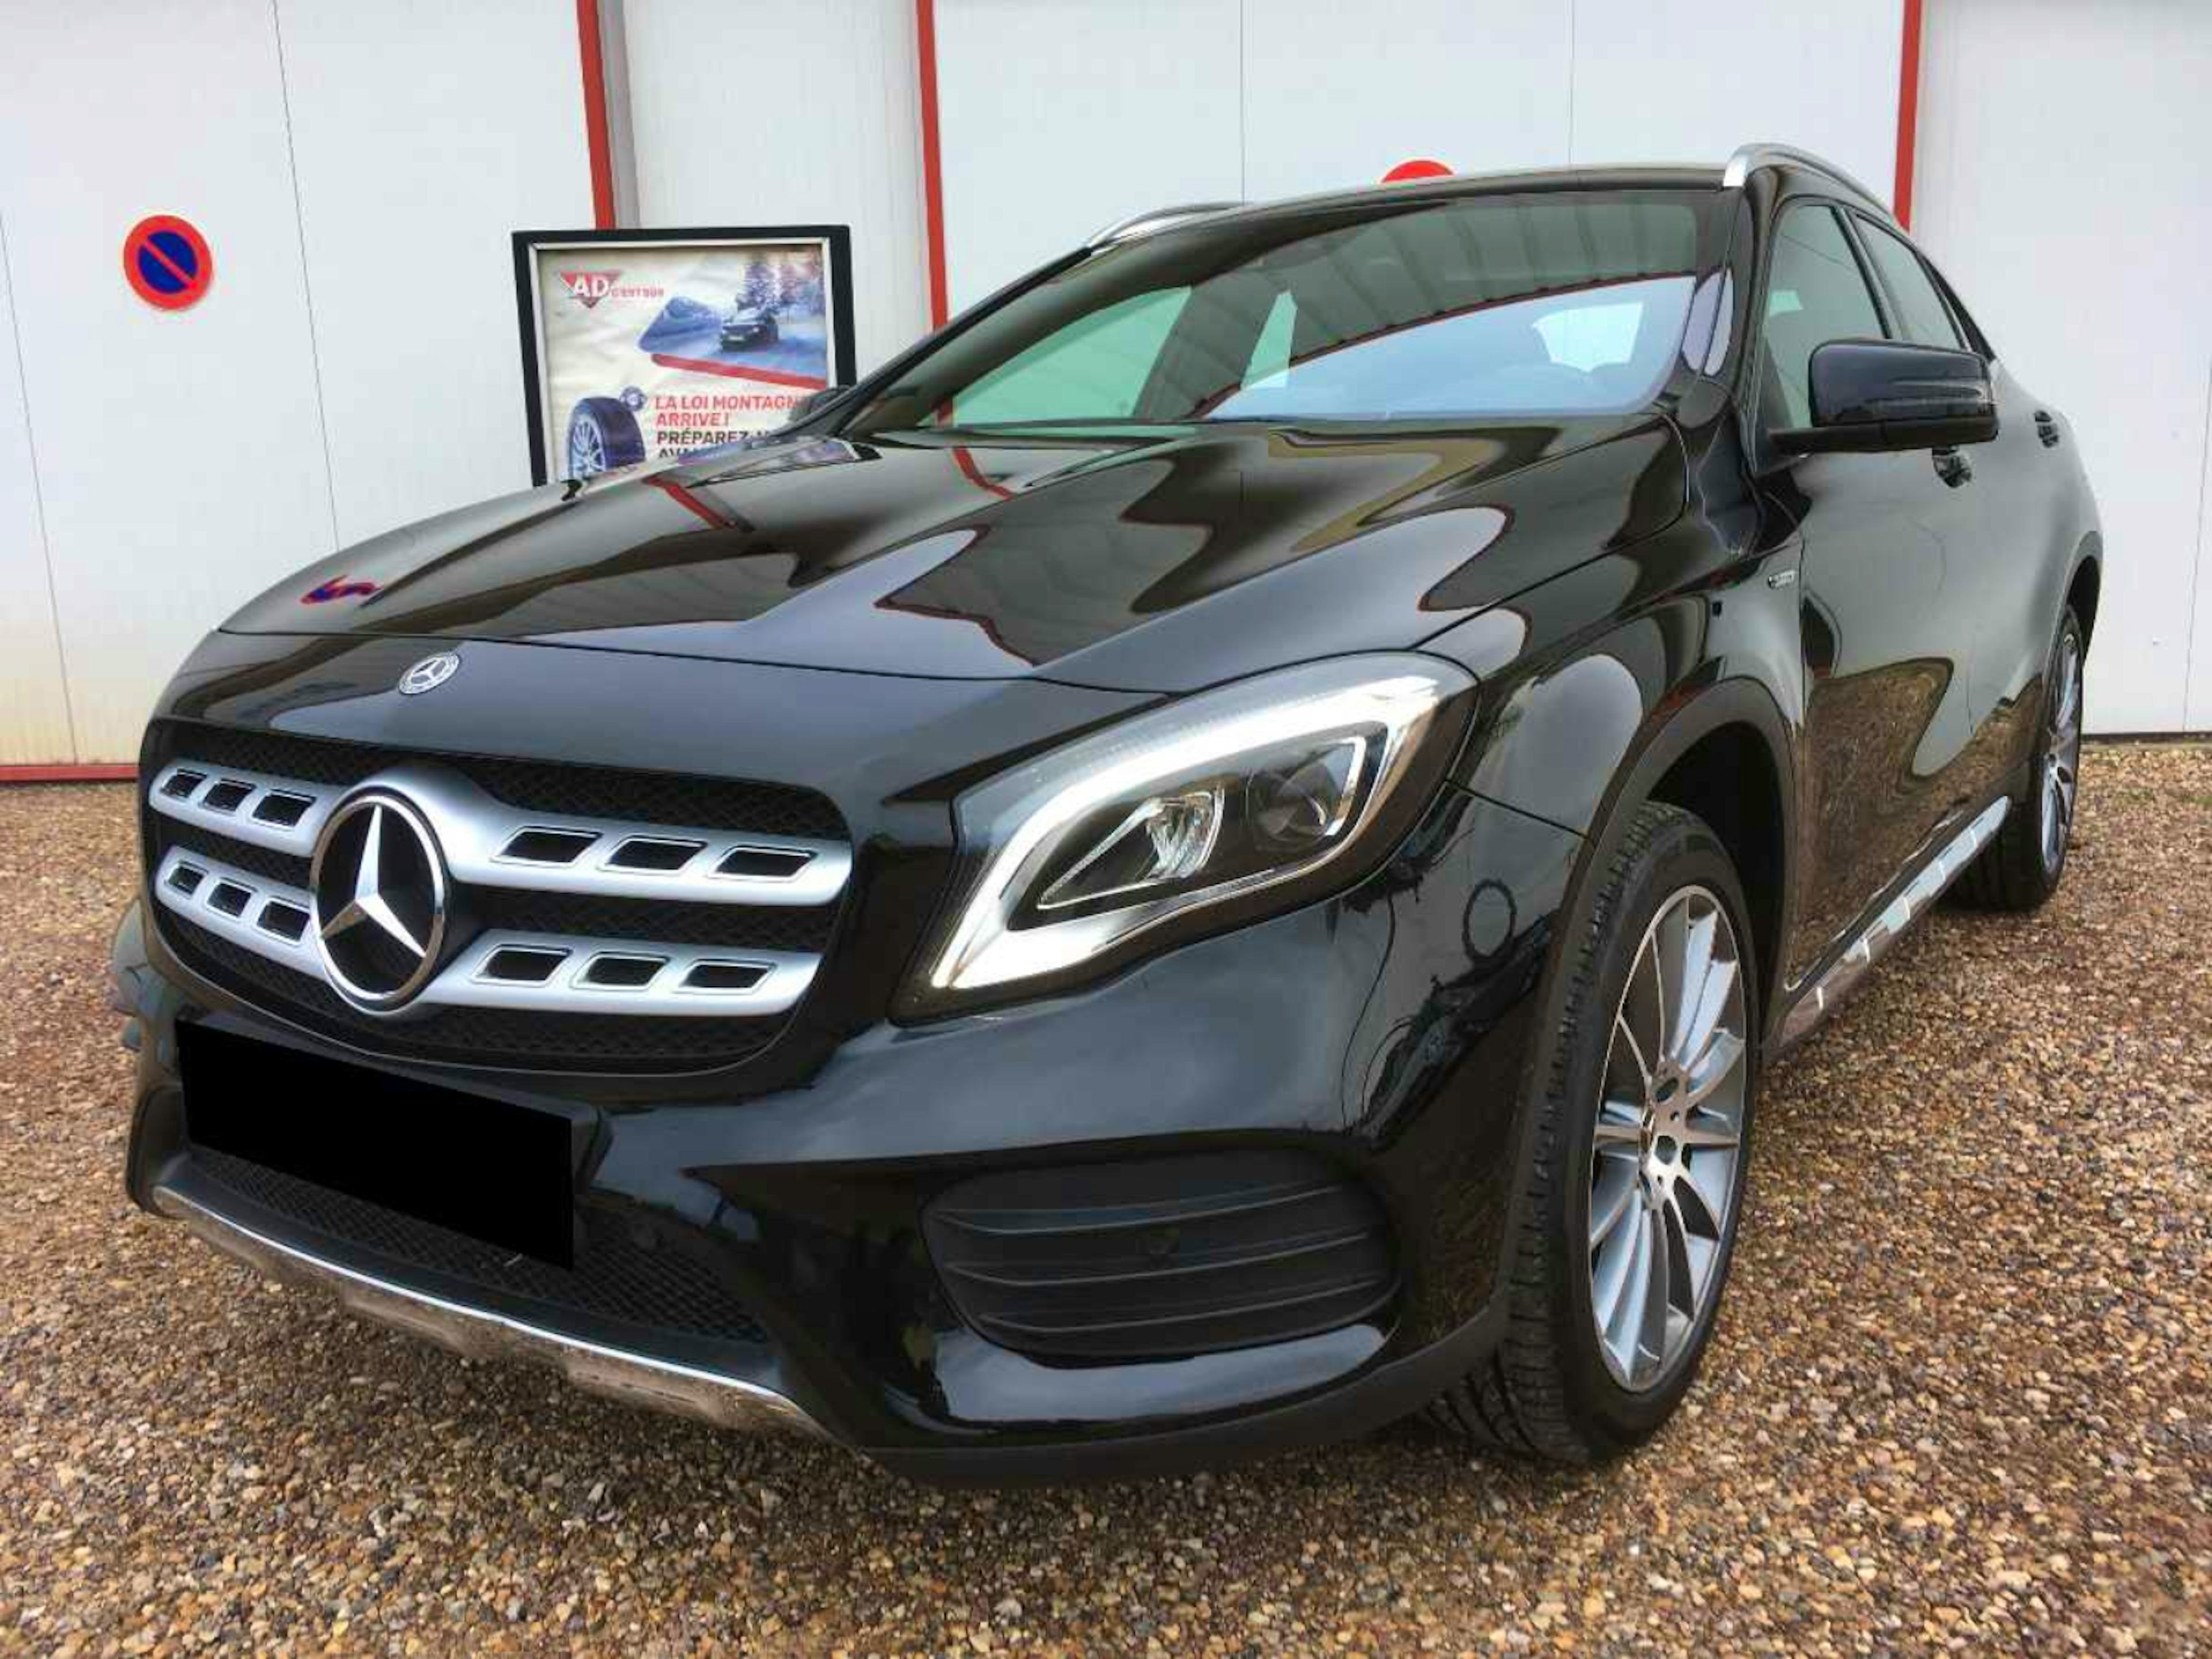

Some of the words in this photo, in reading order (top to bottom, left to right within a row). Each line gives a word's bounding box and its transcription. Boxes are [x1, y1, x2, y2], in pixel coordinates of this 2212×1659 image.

[575, 272, 609, 298] AD
[656, 396, 677, 409] LA
[681, 396, 709, 409] LOI
[713, 396, 800, 410] MONTAGN
[657, 412, 719, 426] ARRIVE
